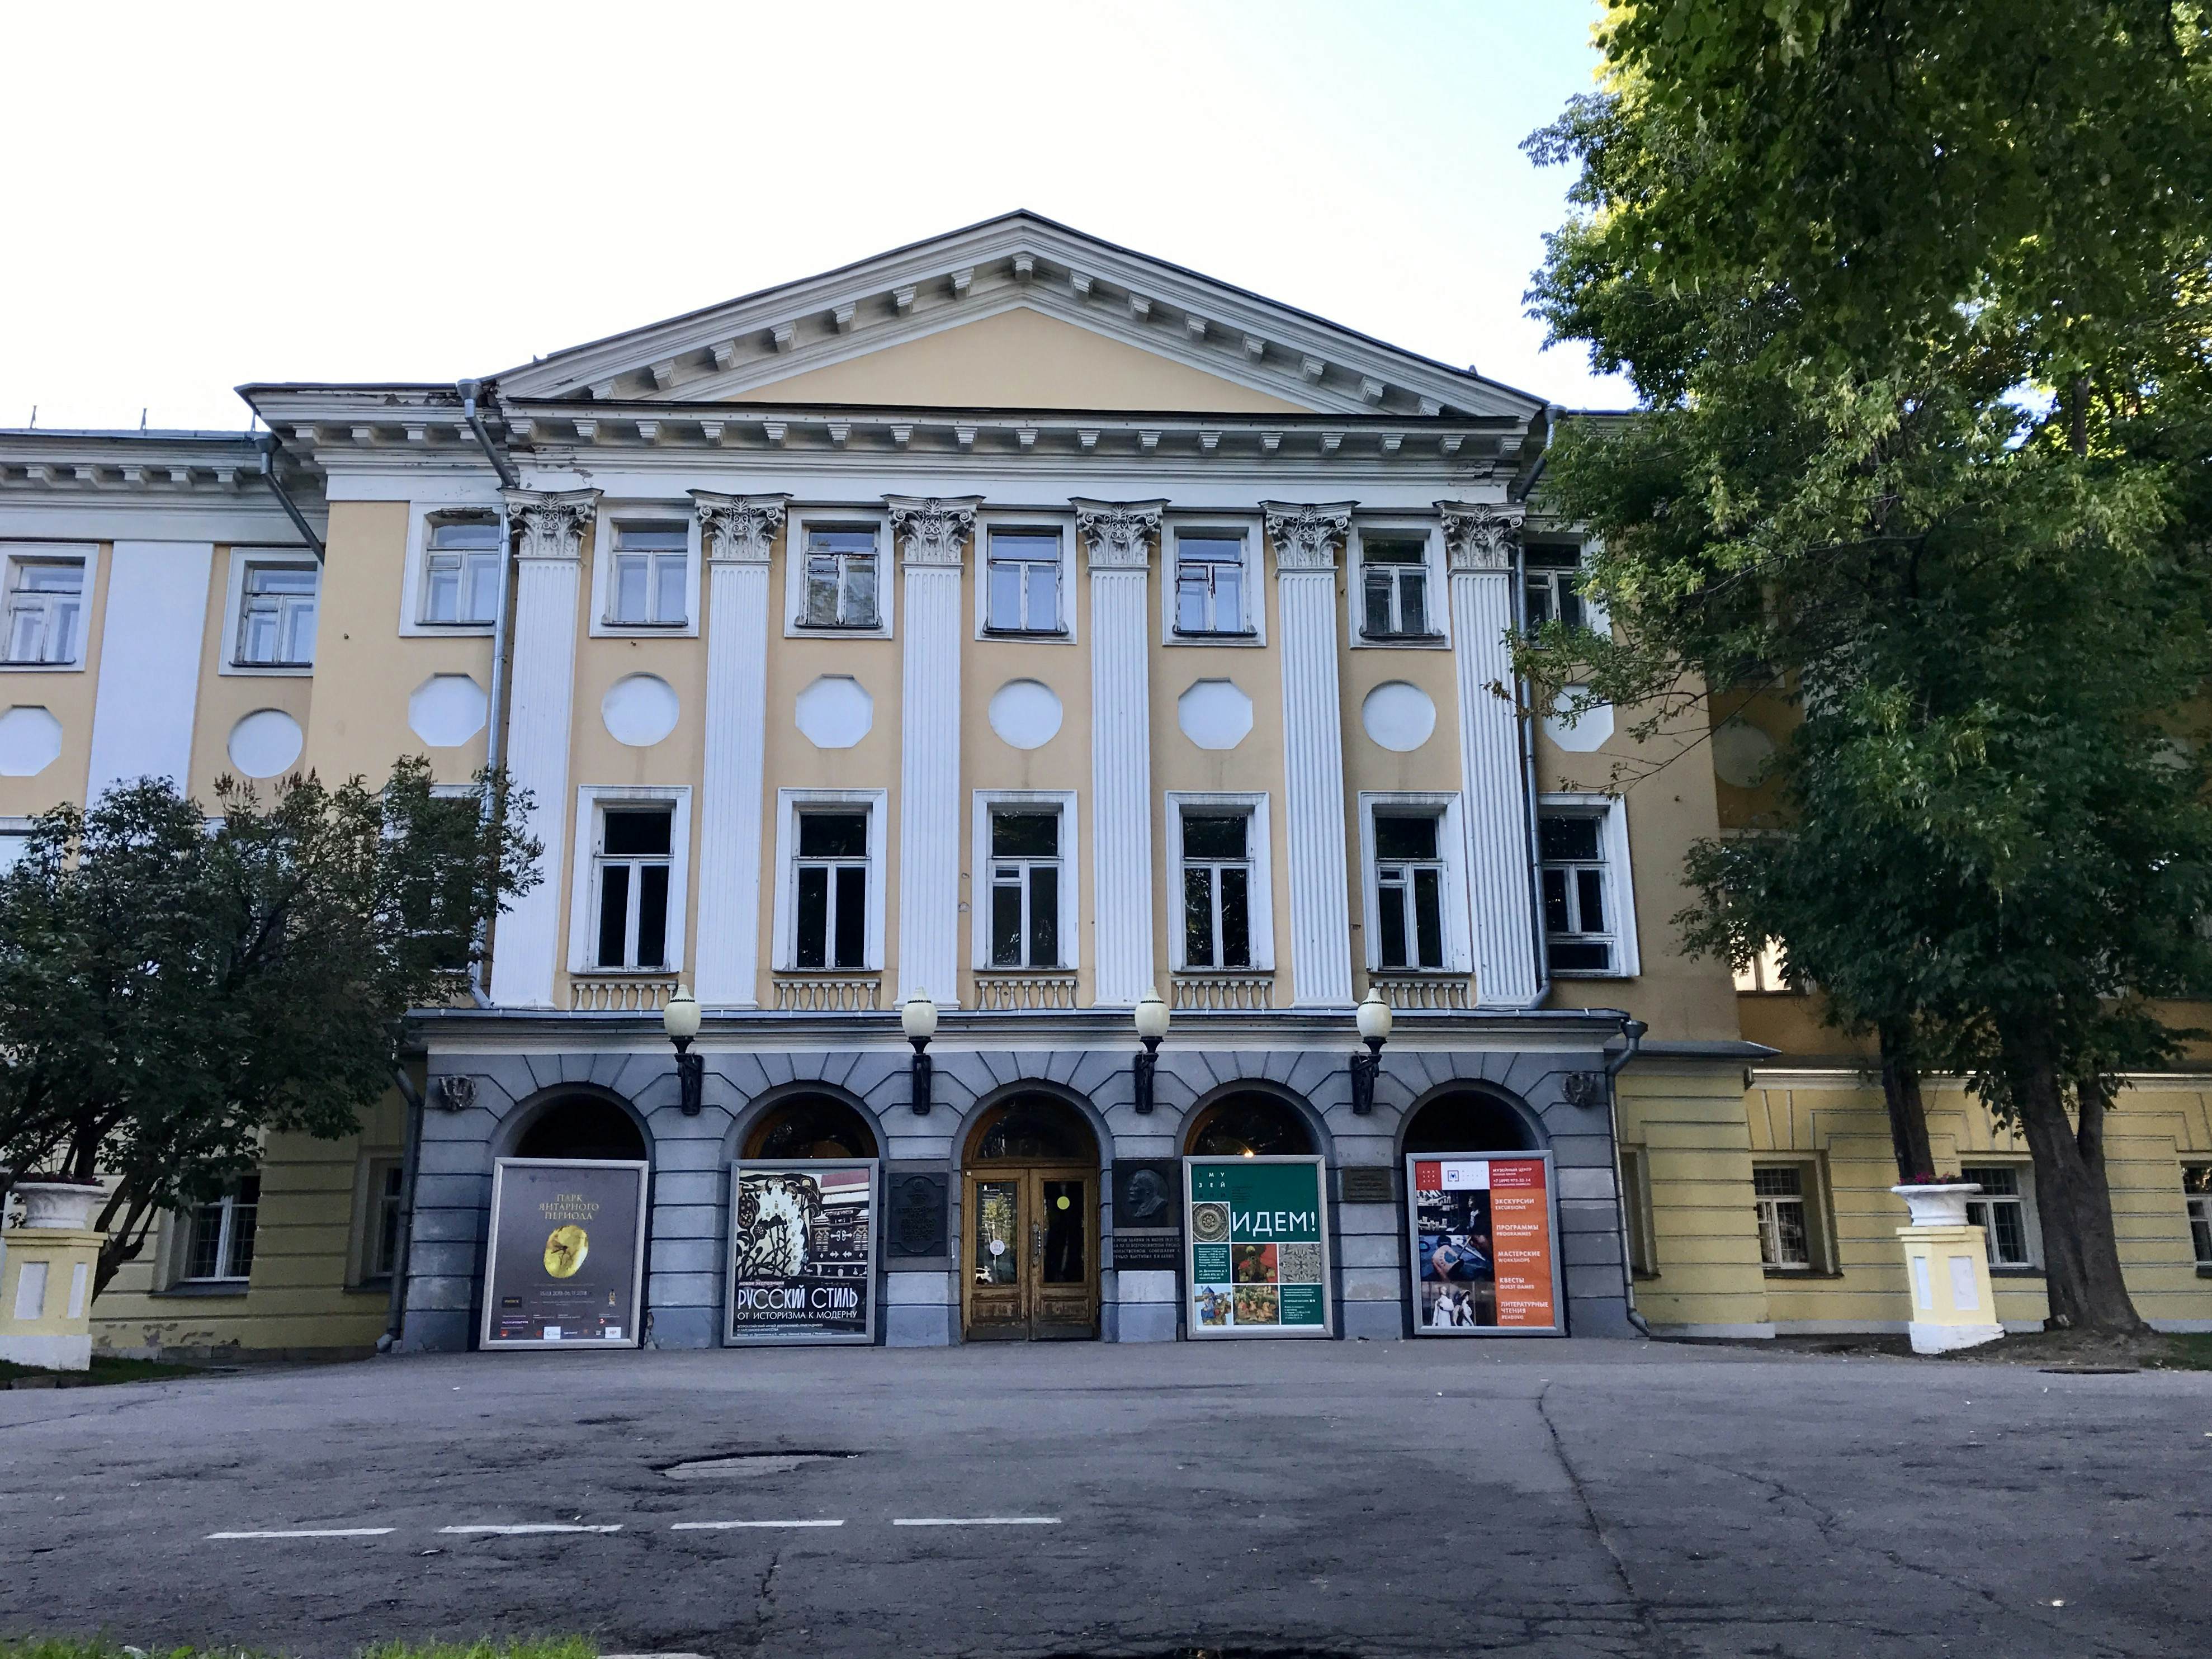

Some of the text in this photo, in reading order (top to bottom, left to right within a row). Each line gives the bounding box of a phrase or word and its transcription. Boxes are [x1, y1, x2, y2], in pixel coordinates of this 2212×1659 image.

[557, 1194, 582, 1202] ПАРК
[539, 1203, 599, 1211] ЯНТАРНОГО
[545, 1212, 593, 1220] ПЕРИОДА
[1232, 1211, 1316, 1237] ИДЕМ!
[738, 1284, 858, 1310] РУССКИЙ СТИЛЬ
[737, 1312, 749, 1320] ОТ
[753, 1311, 806, 1320] ИСТОРИЗМА
[816, 1310, 858, 1320] МОДЕРНУ
